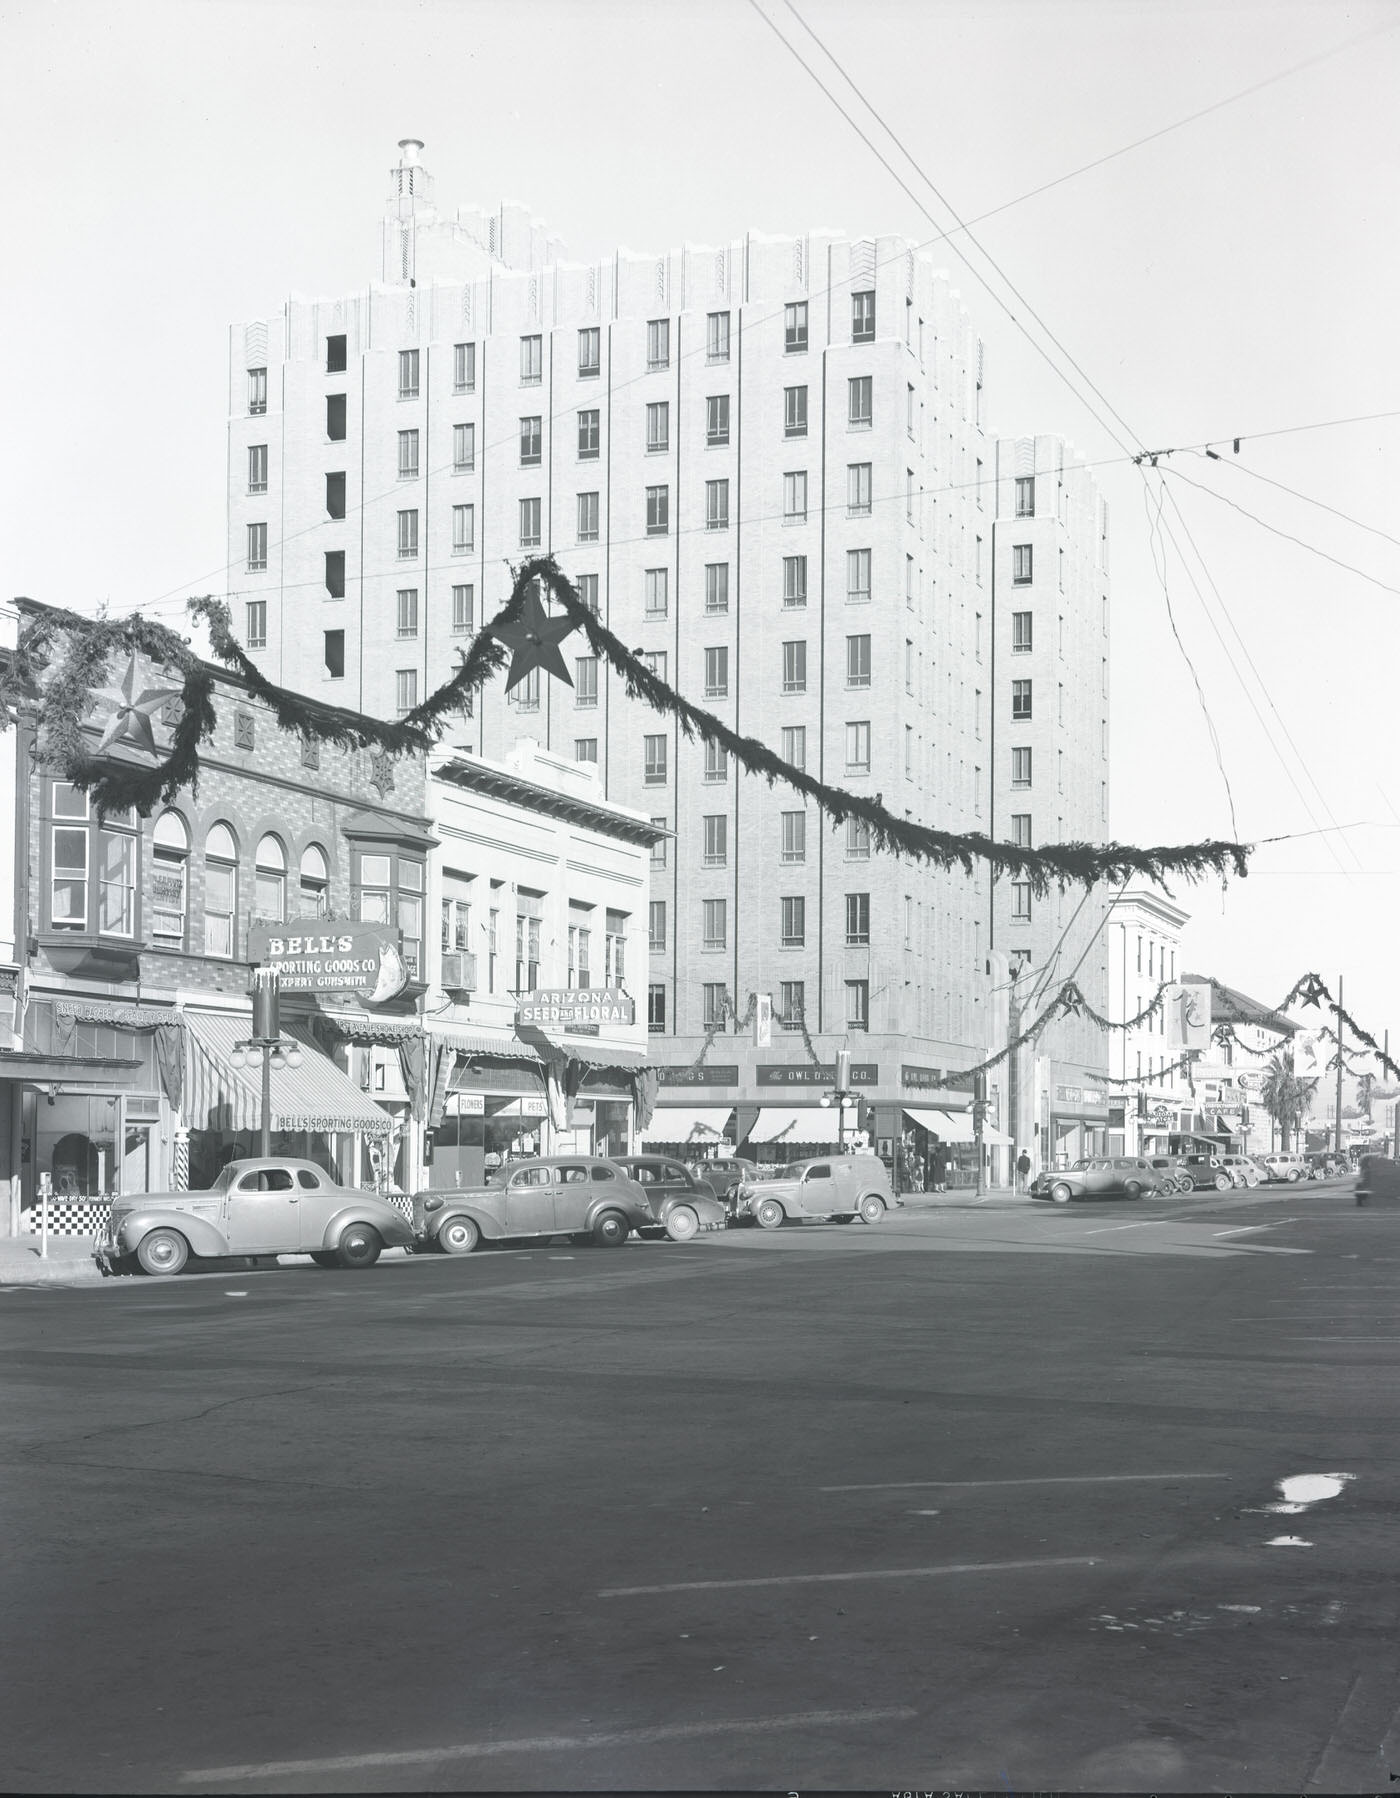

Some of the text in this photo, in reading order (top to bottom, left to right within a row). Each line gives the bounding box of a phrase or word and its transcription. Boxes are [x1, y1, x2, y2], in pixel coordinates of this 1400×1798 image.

[269, 936, 353, 955] BELL'S
[325, 960, 360, 973] GOODS
[280, 975, 367, 987] XPERT GUNSMITH
[540, 992, 613, 1004] ARIZONA
[524, 1007, 559, 1020] SEED
[575, 1006, 628, 1020] FLORAL
[788, 1071, 810, 1080] OWL
[461, 1100, 543, 1112] FLOWERS PETS
[279, 1117, 391, 1130] BELL'S SPORTING GOODS CO
